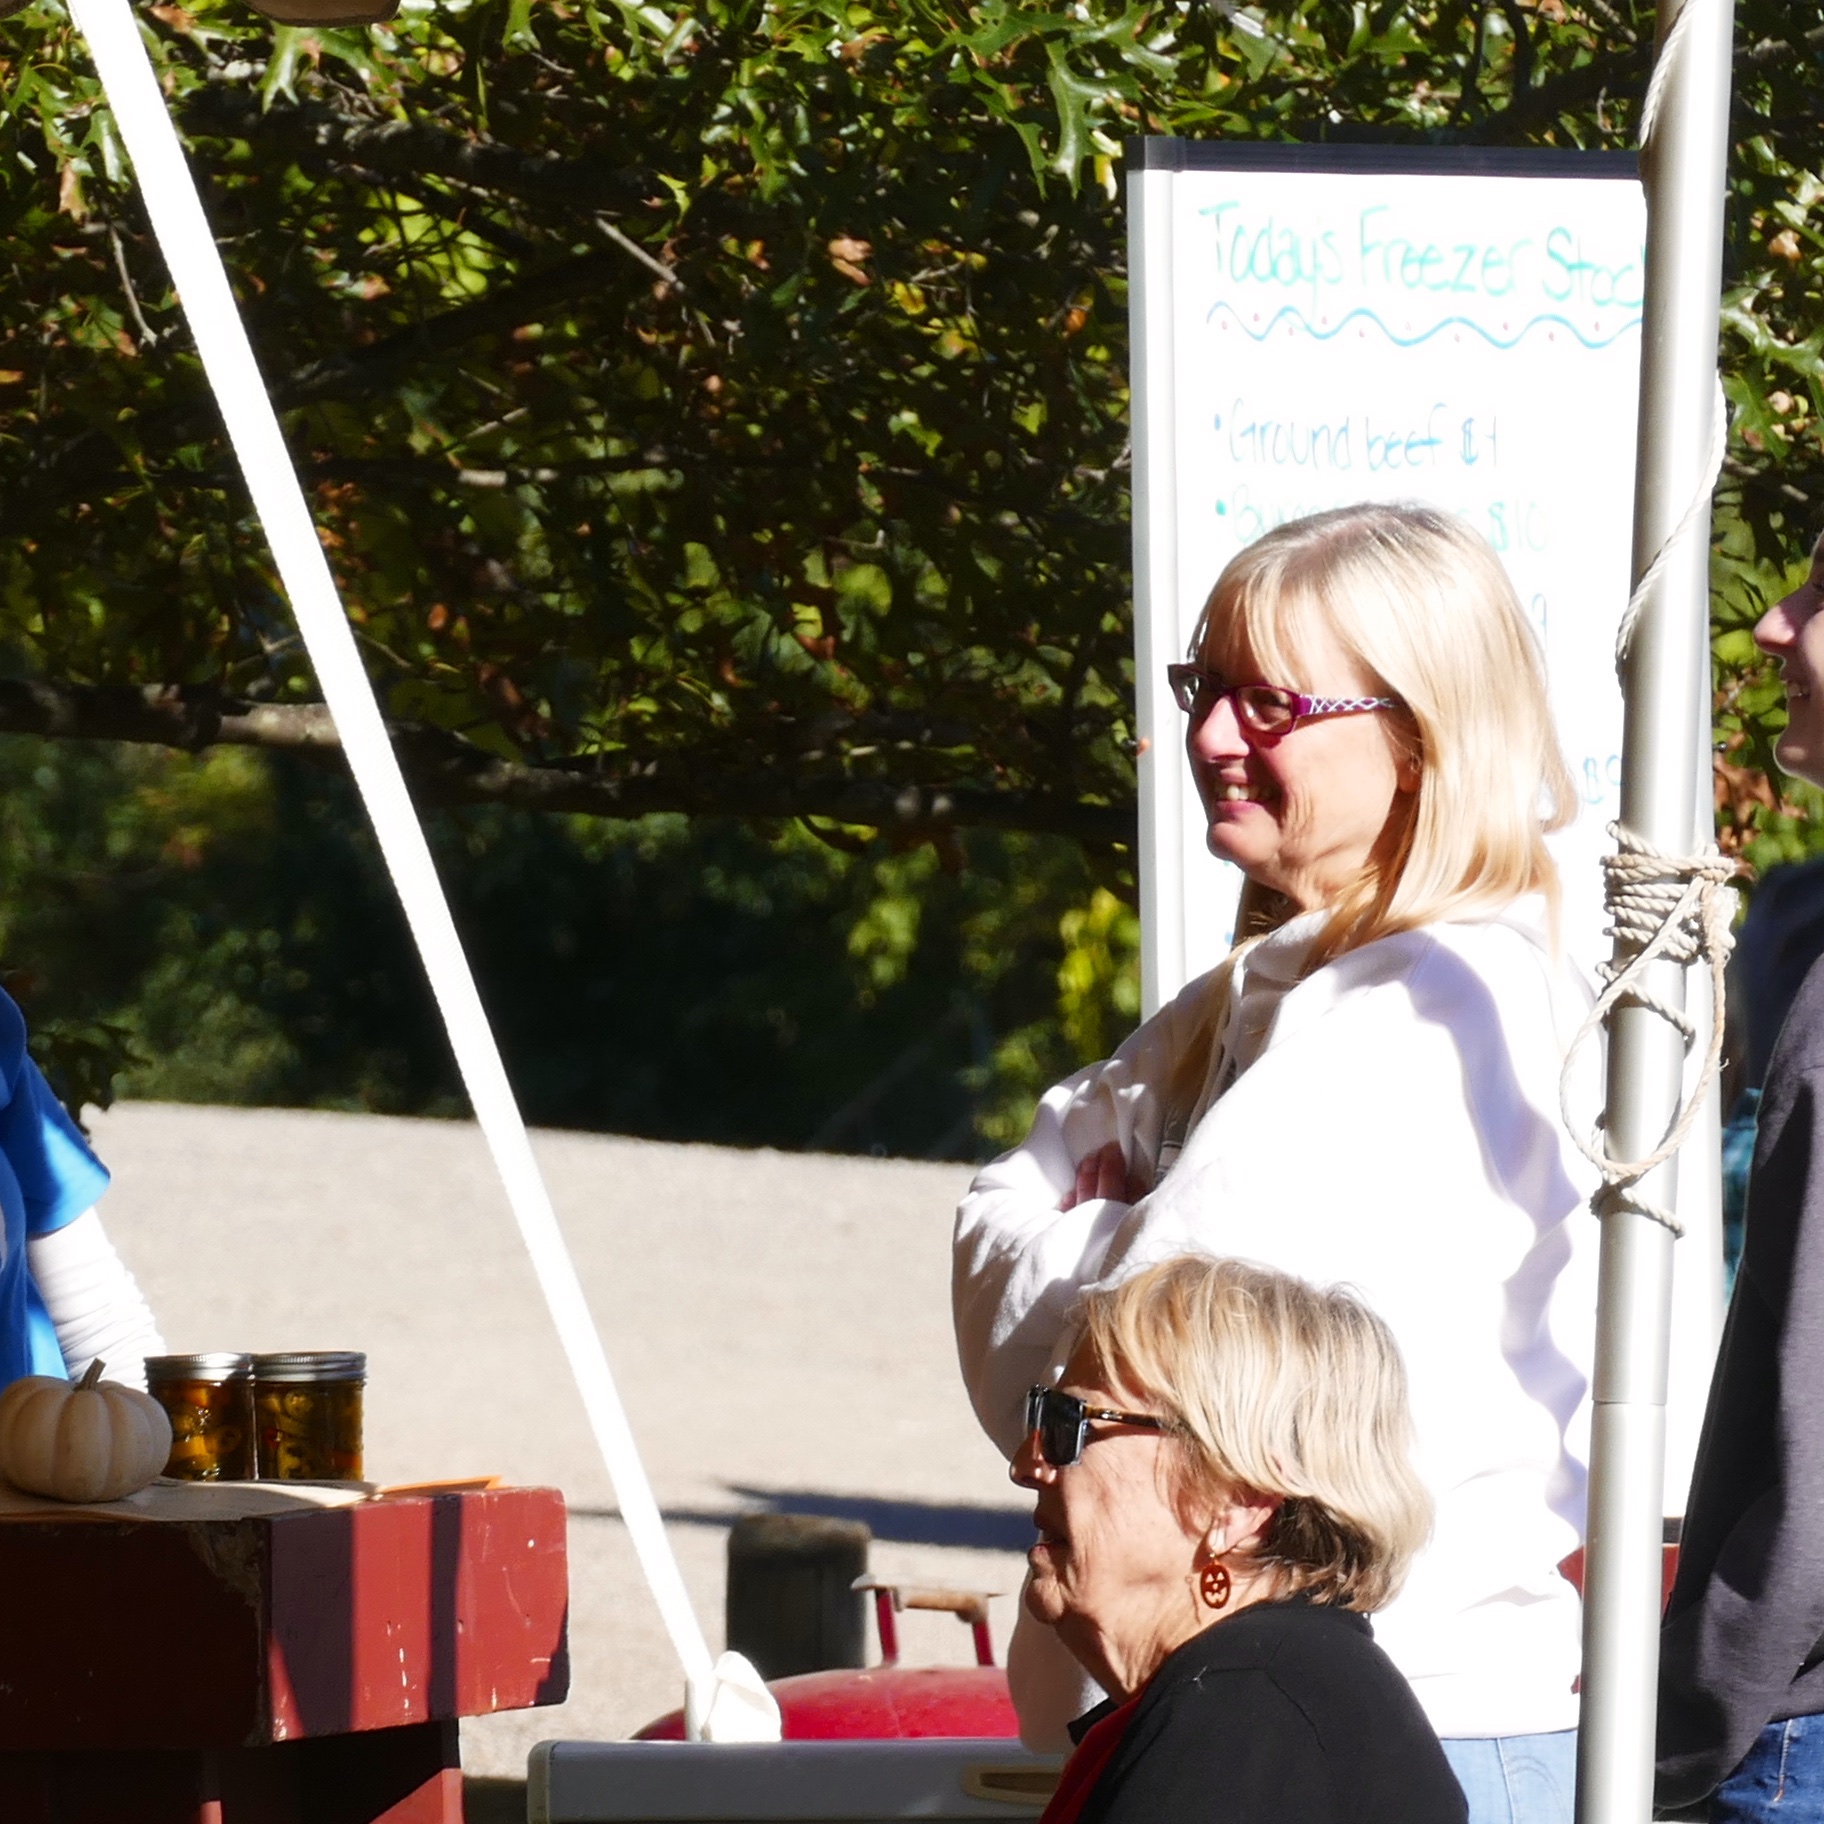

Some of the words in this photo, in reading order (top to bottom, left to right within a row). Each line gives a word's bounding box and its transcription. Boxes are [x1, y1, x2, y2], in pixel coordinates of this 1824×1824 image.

[1359, 203, 1534, 297] Freezer
[1542, 226, 1646, 308] Stoc
[1227, 397, 1353, 471] Ground
[1365, 402, 1448, 471] beef
